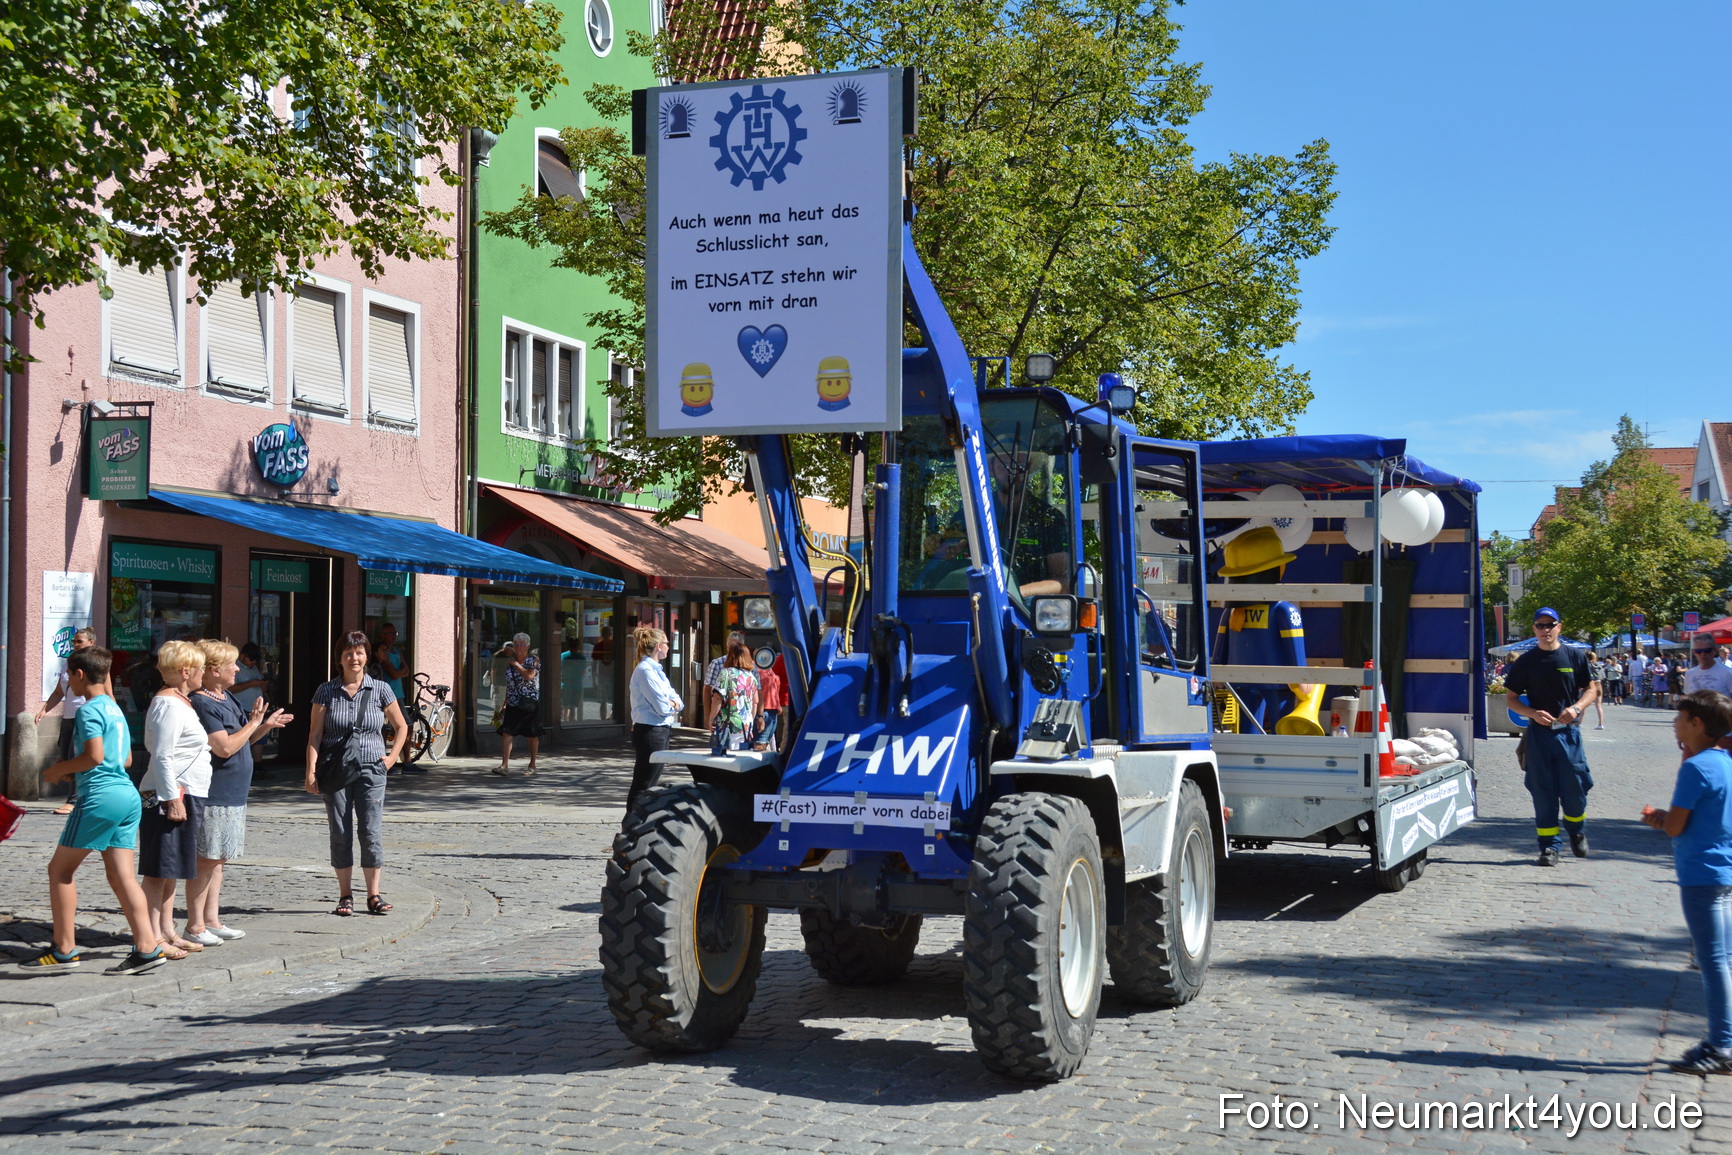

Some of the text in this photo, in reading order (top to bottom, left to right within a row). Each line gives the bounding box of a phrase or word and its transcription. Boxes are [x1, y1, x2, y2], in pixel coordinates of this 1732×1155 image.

[669, 203, 859, 230] Auch wenn ma heut das
[695, 233, 829, 253] Schlusslicht san,
[671, 265, 857, 290] im EINSATZ stehn wir
[708, 293, 818, 313] vorn mit dran
[98, 432, 121, 449] vom
[105, 436, 140, 461] FASS
[253, 429, 284, 453] vom
[263, 444, 309, 478] FASS
[535, 462, 579, 483] METZGEREI
[112, 551, 214, 578] Spirituosen Whisky
[267, 568, 303, 584] Feinkost
[369, 572, 389, 590] Essig
[52, 630, 69, 645] vom
[57, 640, 74, 657] FA
[804, 732, 955, 776] THW
[761, 799, 949, 821] #(Fast) immer vorn dabei
